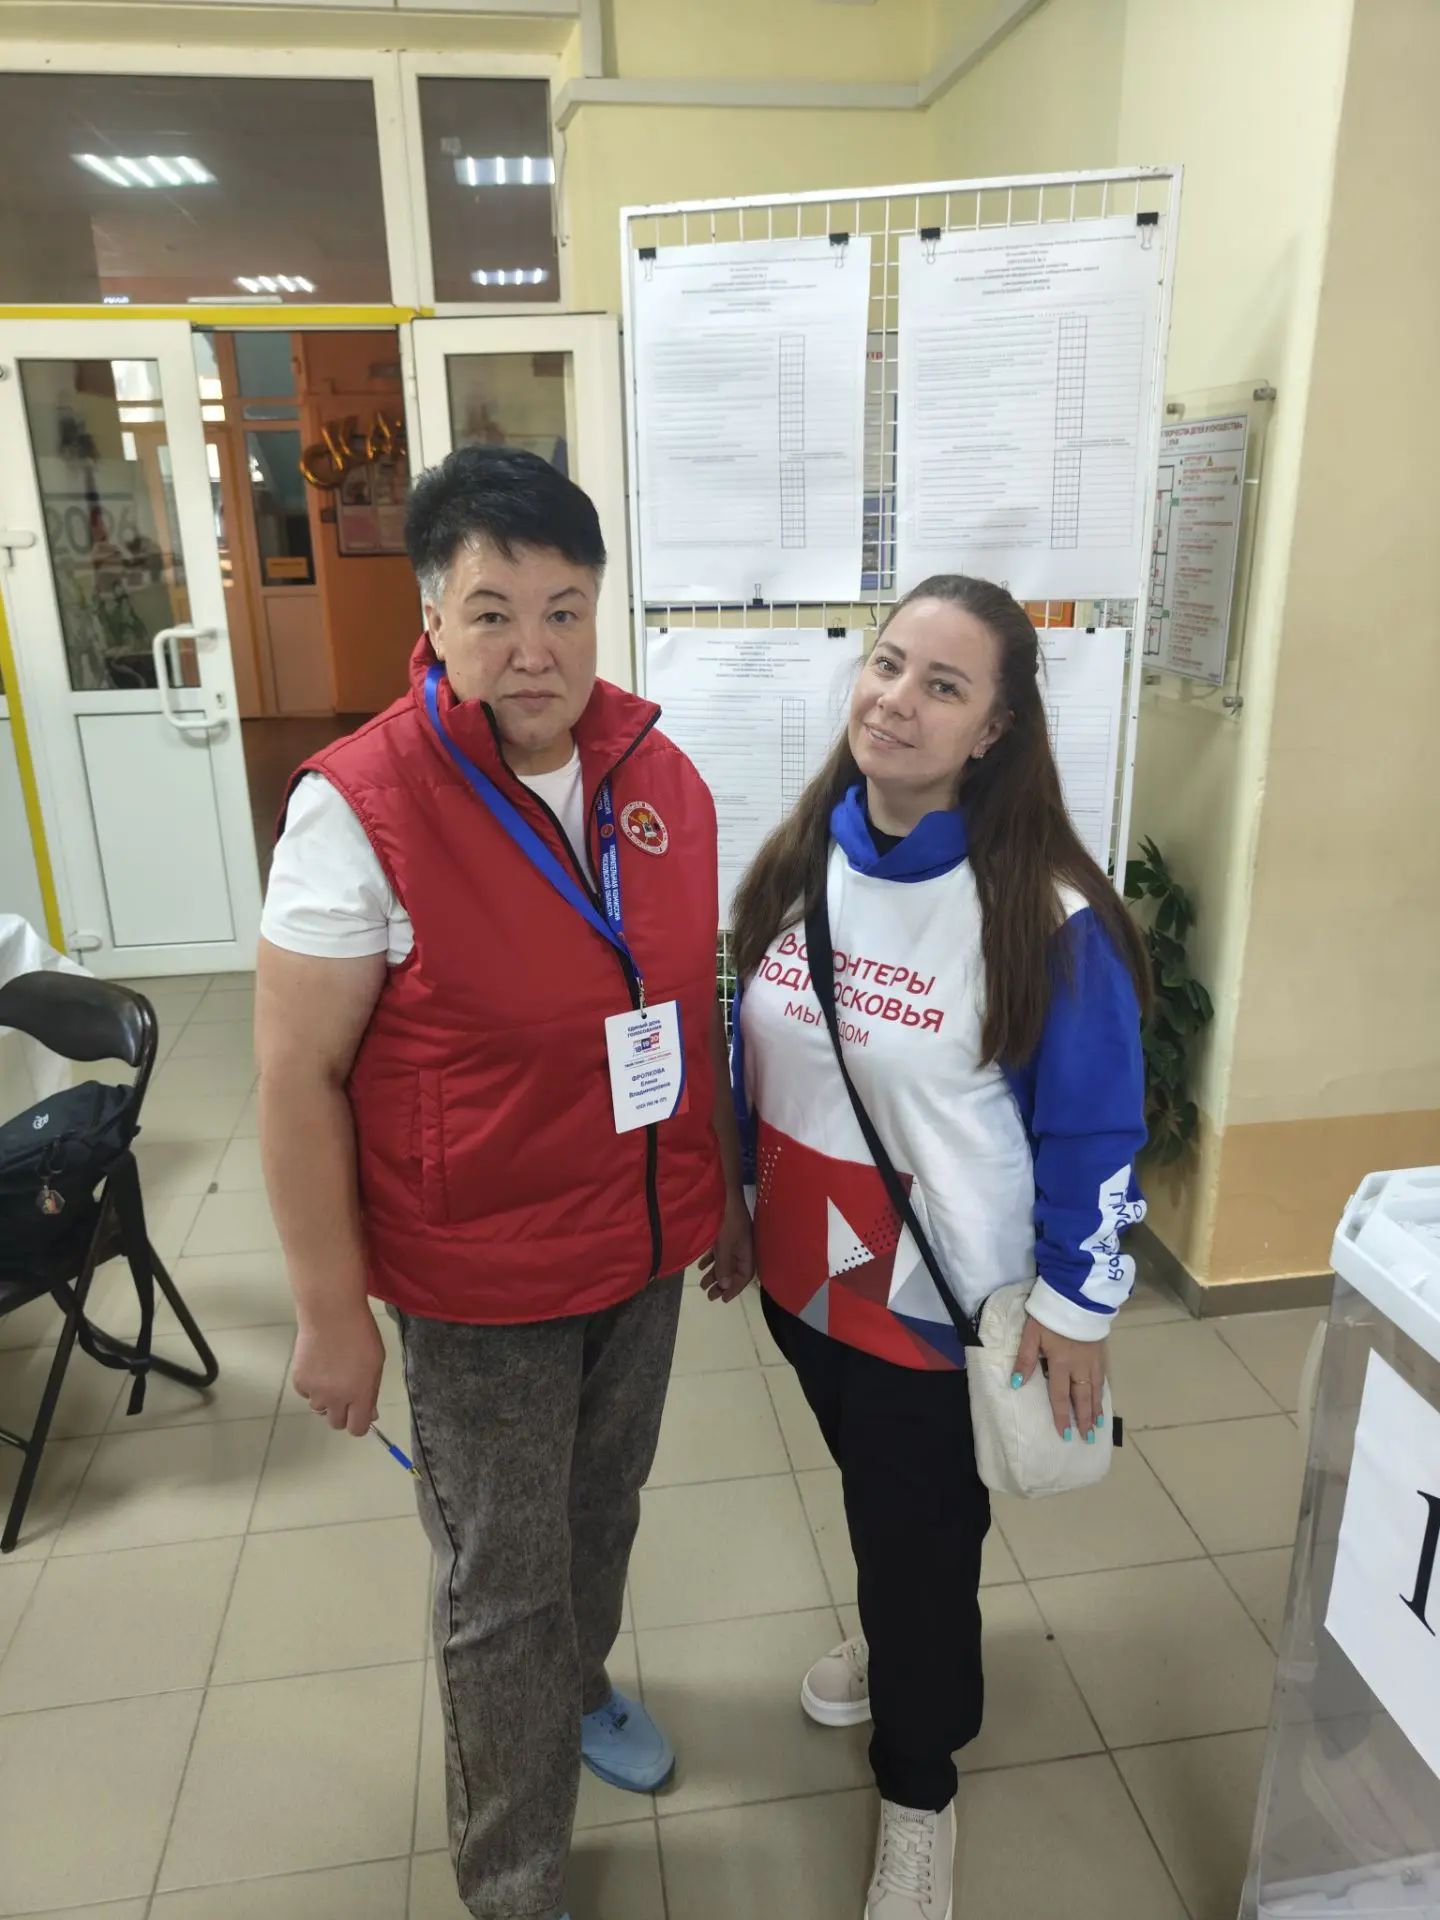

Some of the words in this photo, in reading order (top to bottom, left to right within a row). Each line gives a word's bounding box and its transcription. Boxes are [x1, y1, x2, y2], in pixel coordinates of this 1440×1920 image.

[776, 932, 936, 996] ВООНТЕРЫ
[784, 1001, 822, 1026] МЫ
[650, 1034, 659, 1042] 20
